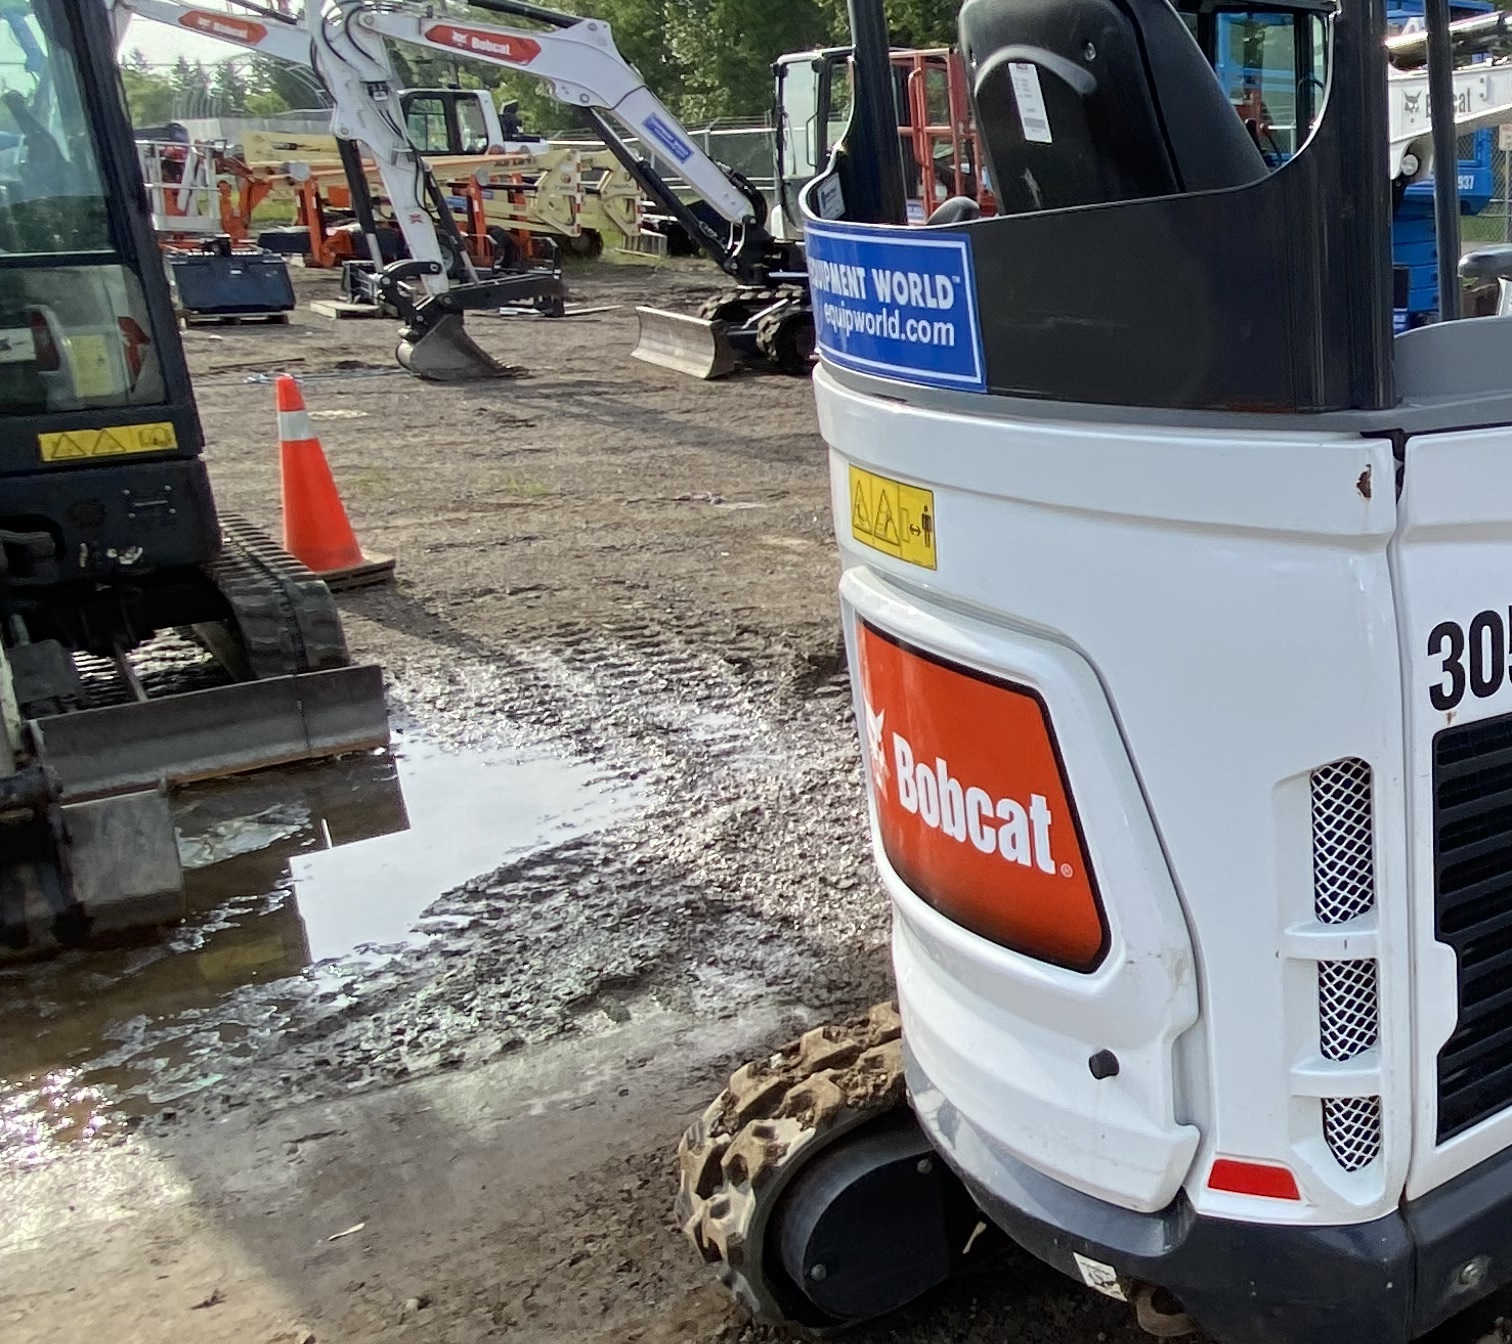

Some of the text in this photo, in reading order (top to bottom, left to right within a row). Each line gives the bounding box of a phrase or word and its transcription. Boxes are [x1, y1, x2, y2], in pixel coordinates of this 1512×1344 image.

[471, 36, 511, 56] Bobcat
[871, 268, 955, 310] WORLD
[823, 300, 955, 346] equipworld.com
[893, 731, 1057, 876] Bobcat
